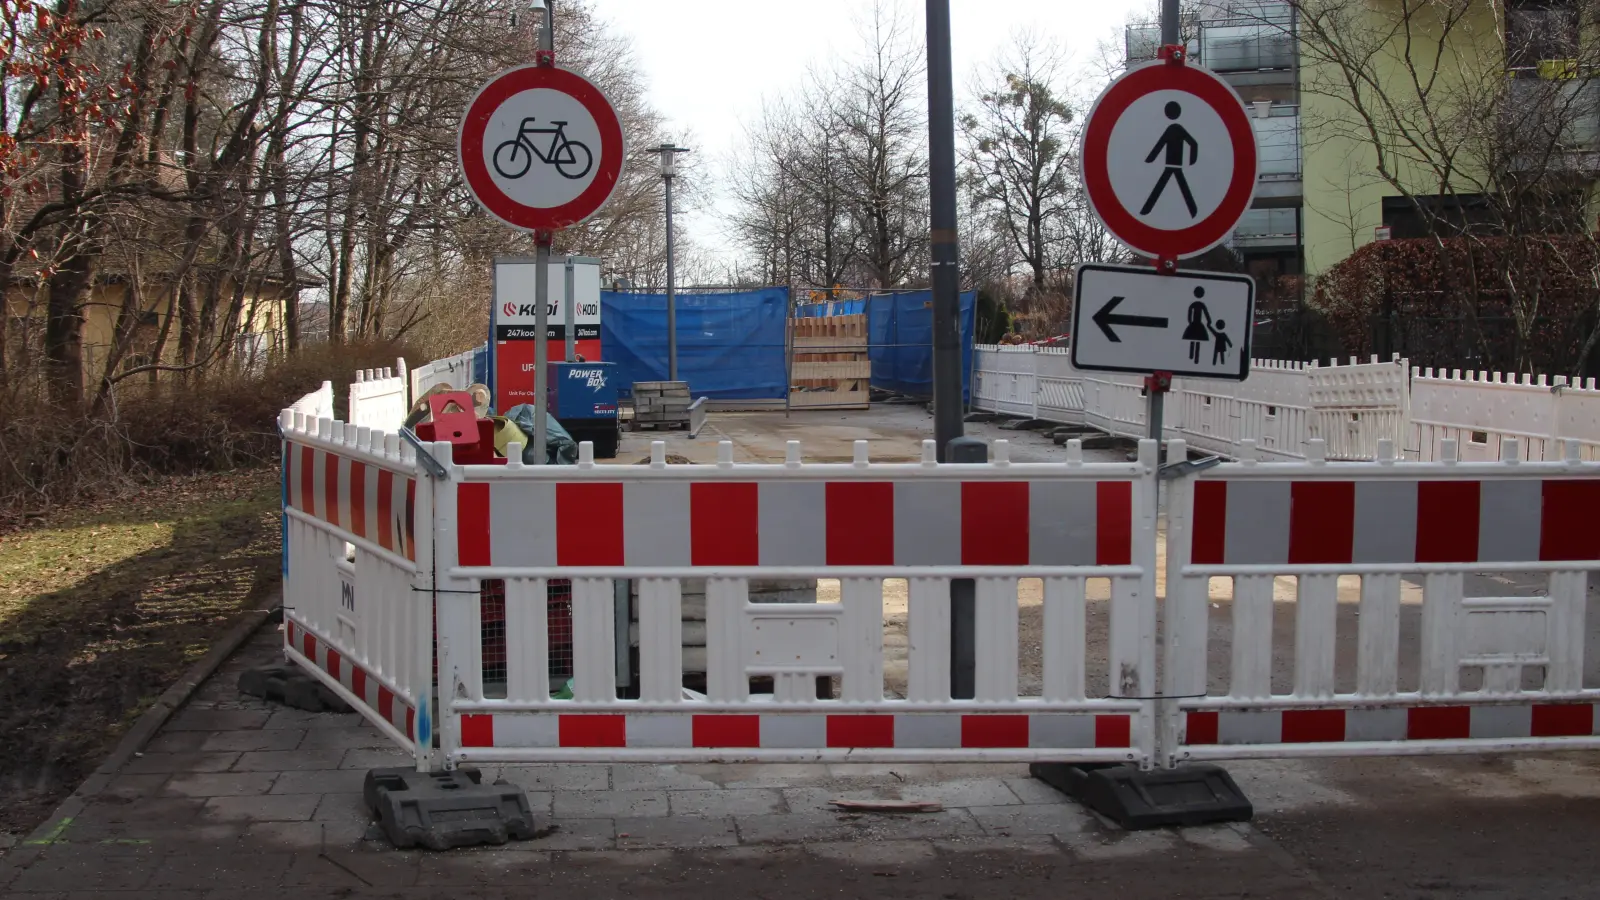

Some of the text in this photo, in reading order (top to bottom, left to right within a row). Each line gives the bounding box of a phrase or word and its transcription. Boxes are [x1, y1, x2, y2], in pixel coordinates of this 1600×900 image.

[507, 329, 556, 337] 247koom
[568, 369, 603, 379] POWER
[586, 377, 608, 389] BOX
